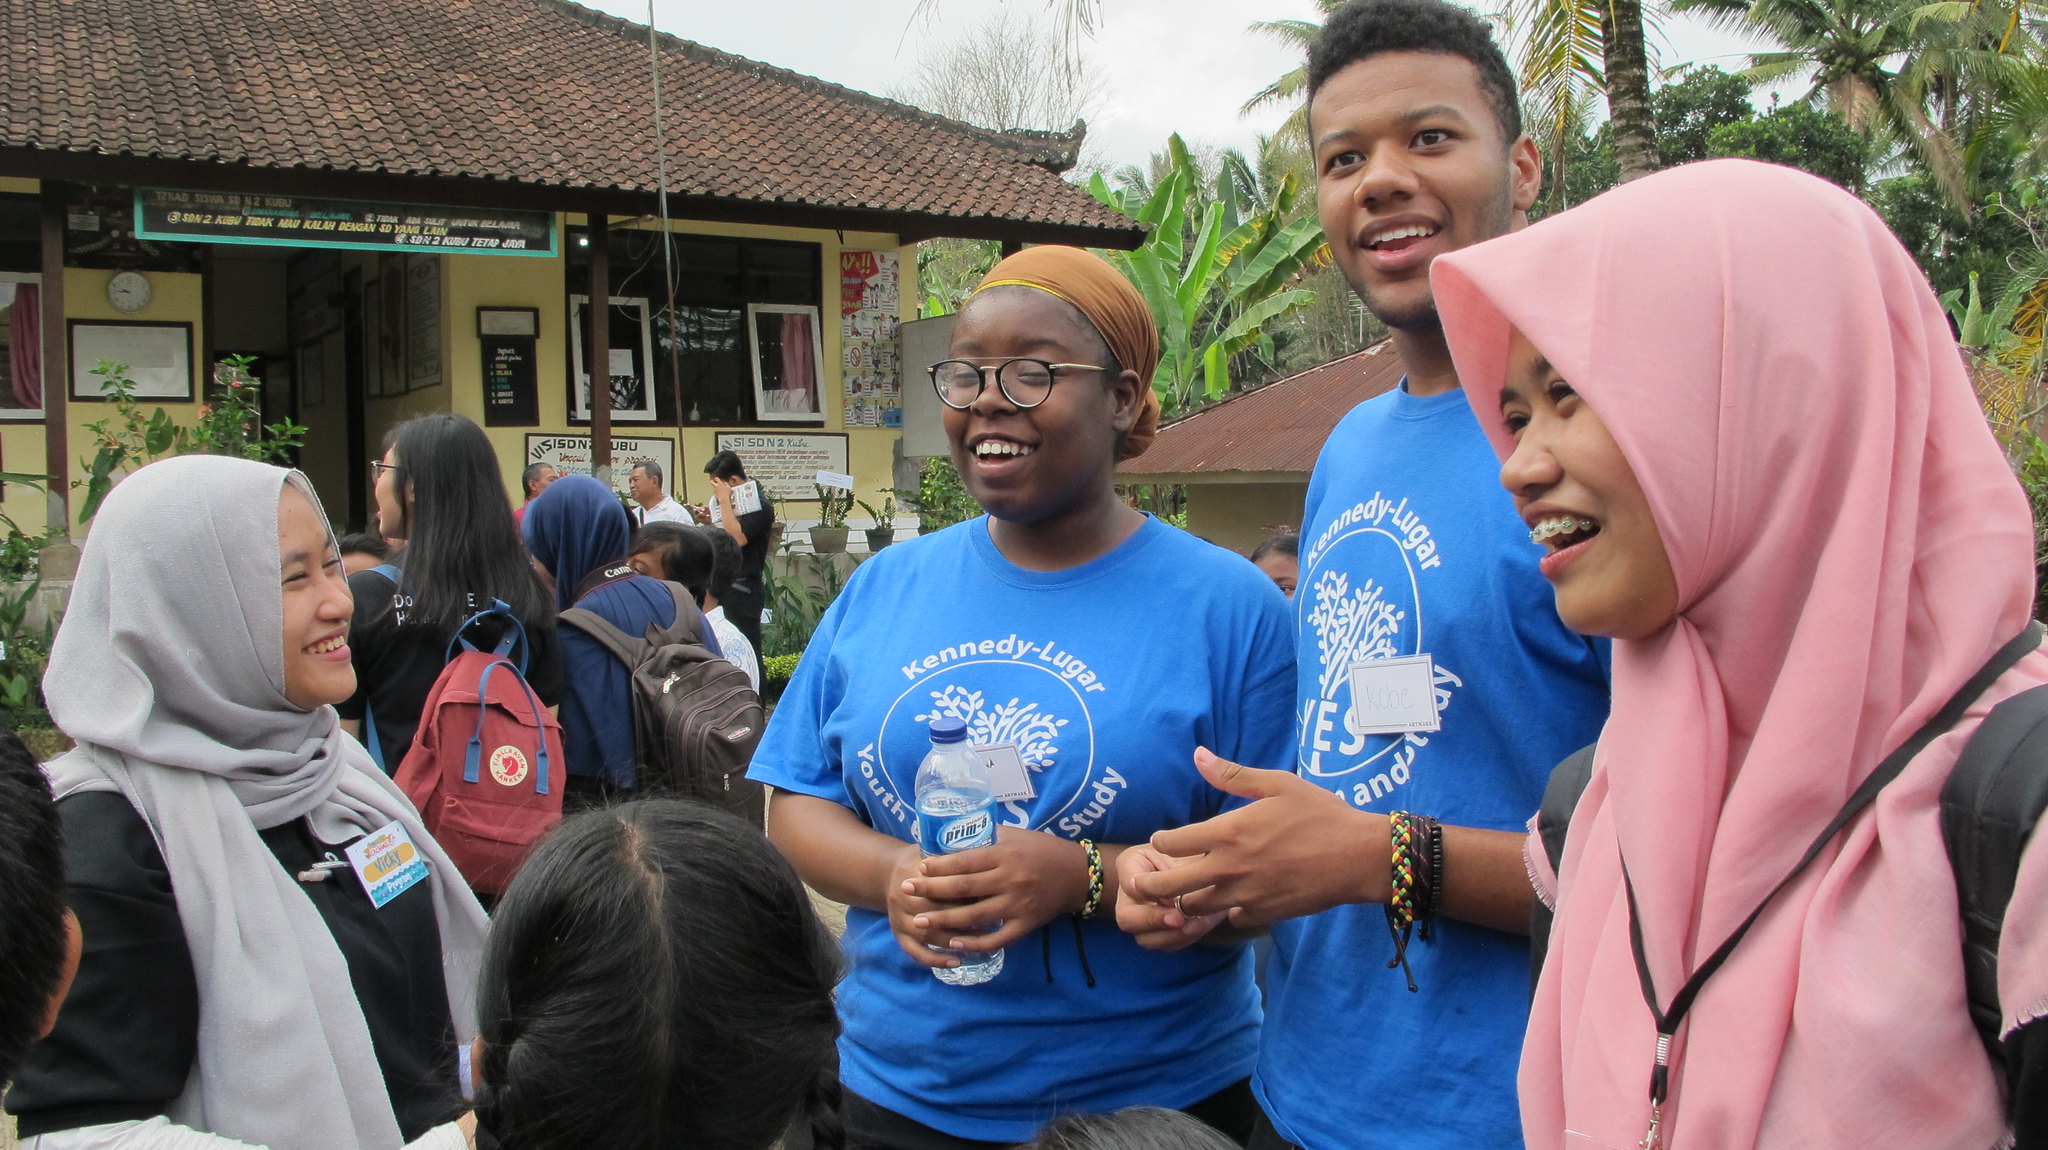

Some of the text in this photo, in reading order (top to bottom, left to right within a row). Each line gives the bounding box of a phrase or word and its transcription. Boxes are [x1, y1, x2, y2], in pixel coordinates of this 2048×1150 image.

[155, 191, 189, 203] TEKAD
[194, 192, 224, 205] SISWA
[265, 197, 292, 208] KUBU
[181, 212, 201, 224] SDN
[215, 214, 242, 226] KUBU
[245, 215, 274, 227] TIDAK
[277, 218, 300, 229] MAU
[302, 219, 336, 231] KALAH
[338, 221, 375, 233] DENGAN
[379, 223, 393, 233] SD
[394, 223, 421, 234] YANG
[423, 226, 448, 237] LAIN
[480, 219, 521, 230] BELAJAR
[442, 236, 470, 246] KUBU
[472, 237, 499, 248] TETAP
[501, 238, 526, 249] JAYA
[610, 441, 638, 451] UBU
[1308, 491, 1441, 571] Kennedy-Lugar
[901, 634, 1106, 693] Kennedy-Lugar
[857, 742, 907, 822] Youth
[1058, 765, 1129, 838] Study
[1353, 752, 1410, 806] and
